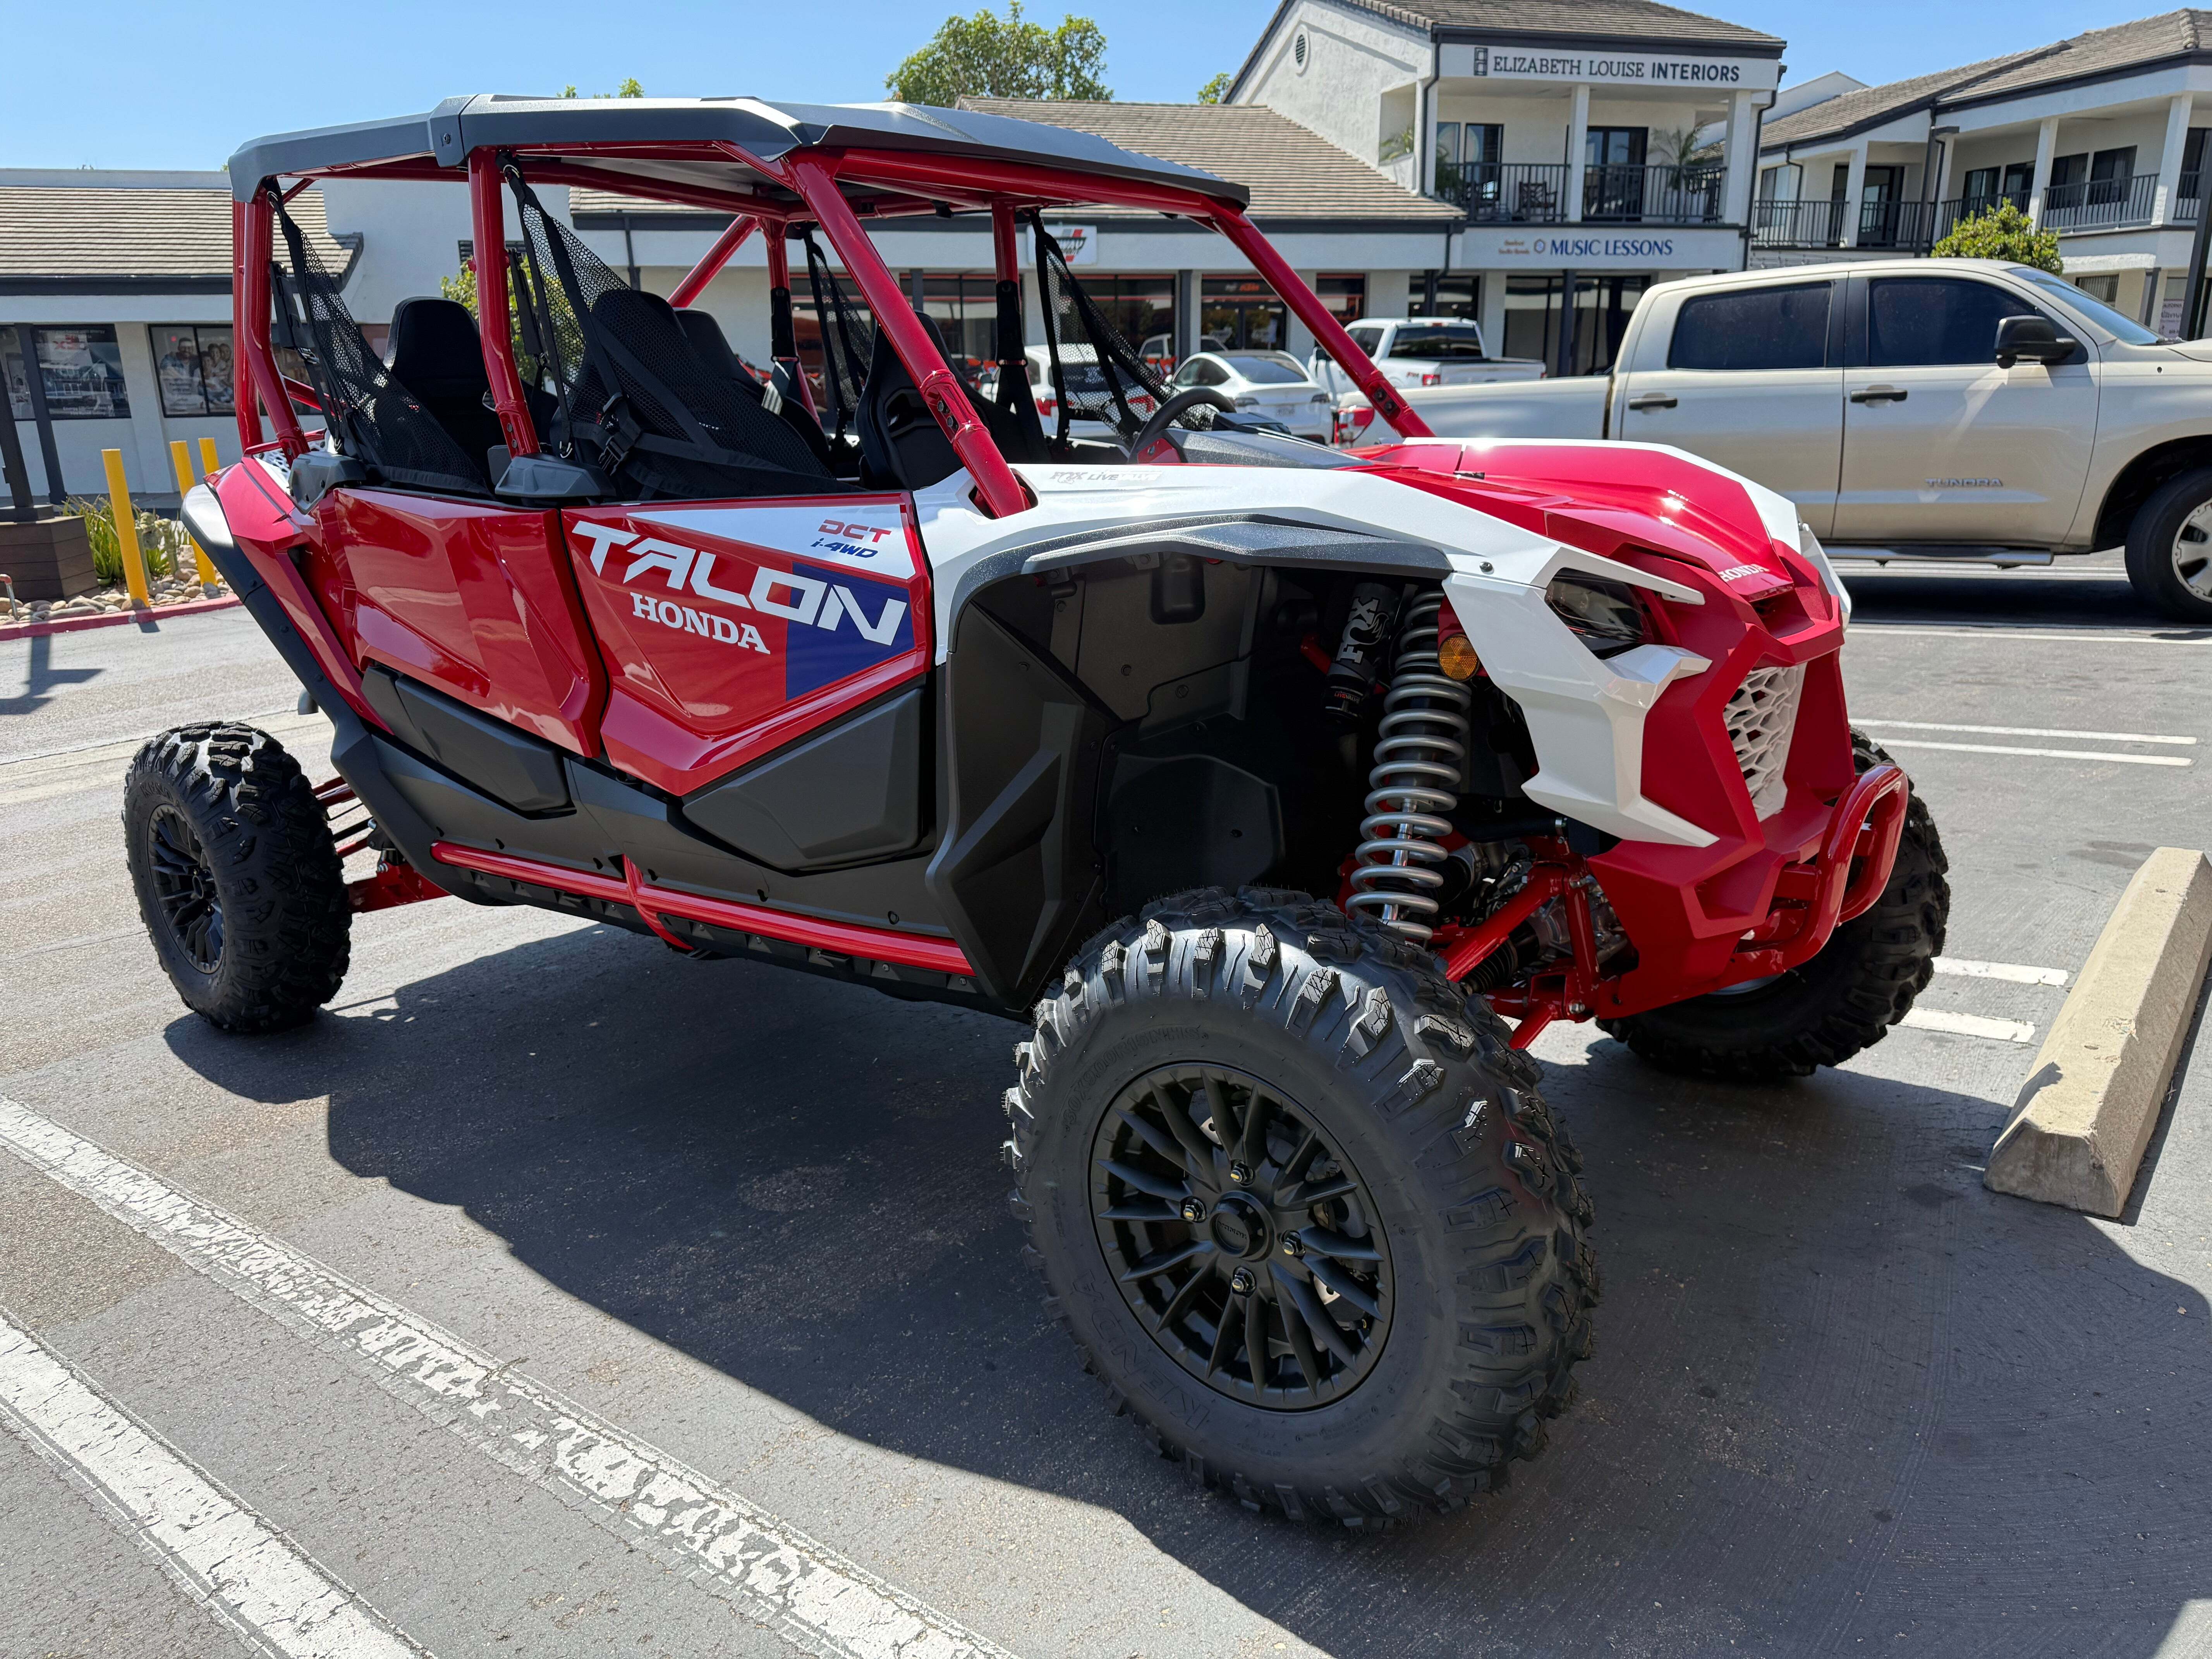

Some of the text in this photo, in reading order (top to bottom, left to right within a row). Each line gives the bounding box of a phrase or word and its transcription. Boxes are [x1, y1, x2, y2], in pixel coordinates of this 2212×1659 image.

[1494, 56, 1740, 82] ELIZABETH LOUISE INTERIORS
[1550, 239, 1673, 256] MUSIC LESSONS
[1049, 471, 1088, 484] FOX
[1925, 478, 2003, 487] TUNDRA
[818, 519, 892, 543] DCT
[811, 537, 879, 558] i-4WD
[572, 520, 907, 646] TALON
[1717, 563, 1770, 582] HONDA
[630, 592, 771, 655] HONDA
[1336, 597, 1389, 664] FOX
[140, 781, 185, 816] KENDA
[1070, 1269, 1210, 1431] KENDA
